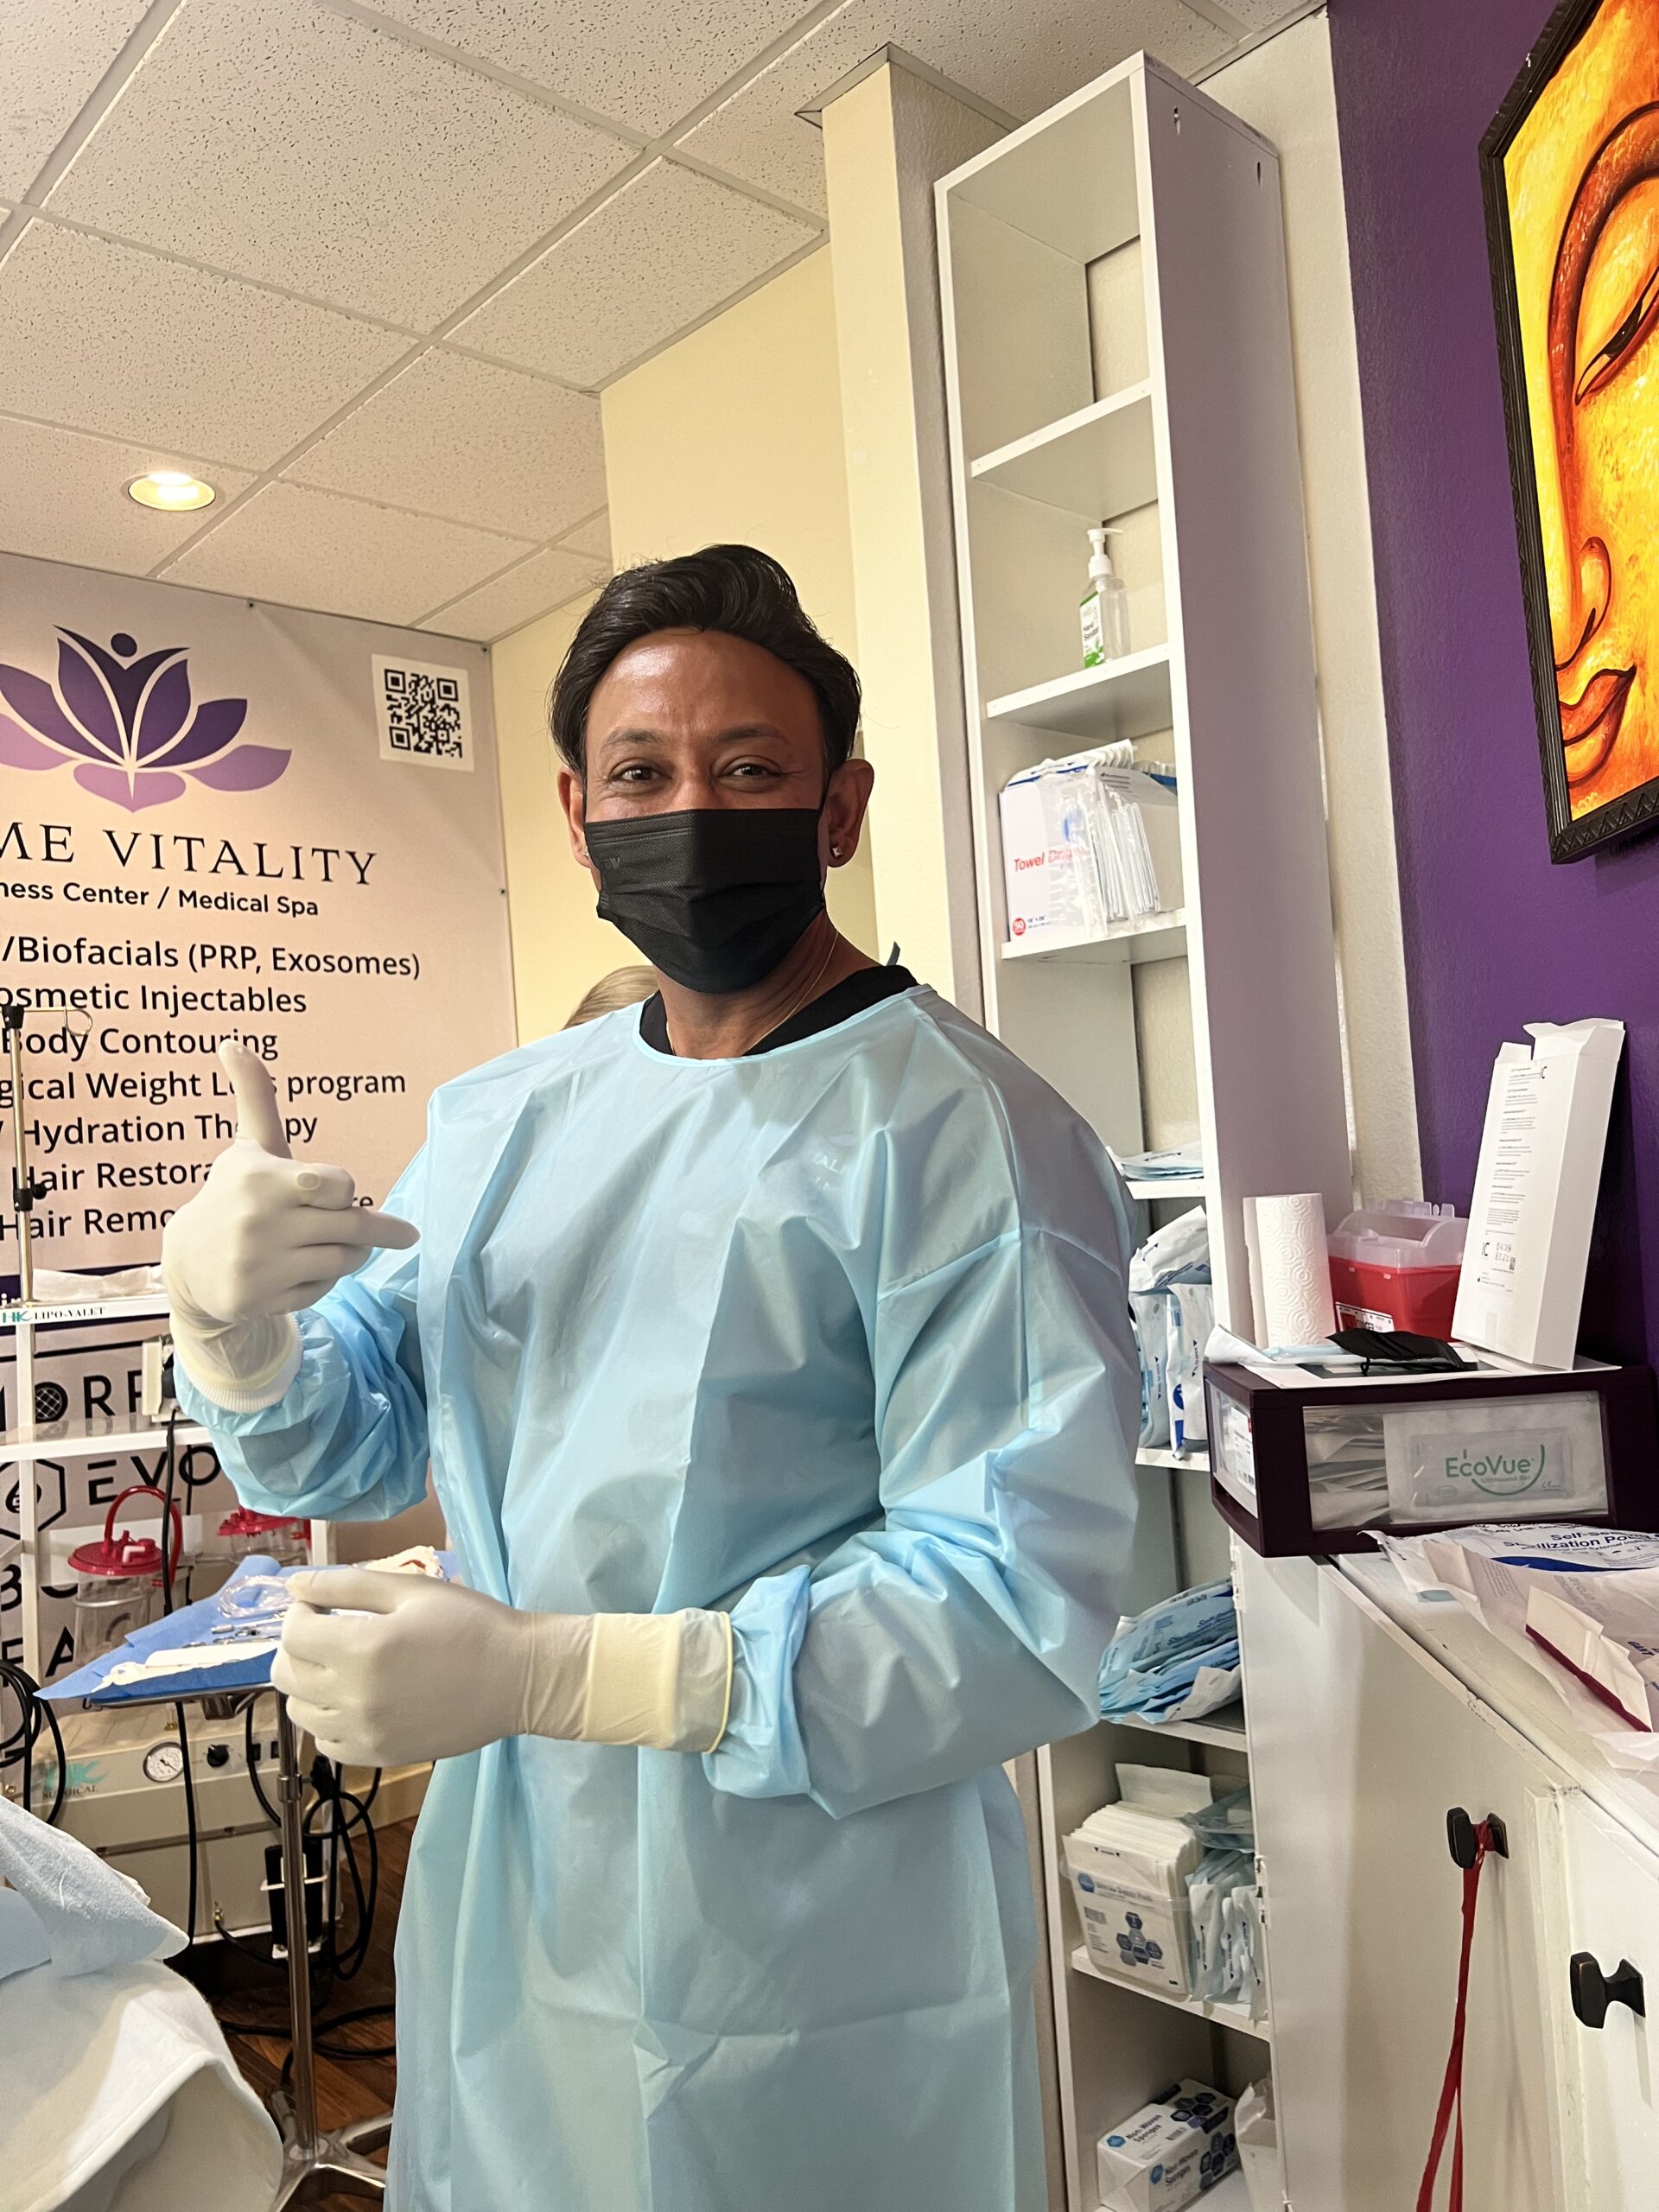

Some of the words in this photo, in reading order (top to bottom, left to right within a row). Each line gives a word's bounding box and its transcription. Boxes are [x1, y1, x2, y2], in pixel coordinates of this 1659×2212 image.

[102, 830, 377, 885] VITALITY
[1014, 851, 1045, 872] Towel
[63, 882, 149, 905] Center
[157, 887, 169, 909] /
[178, 890, 269, 912] Medical
[276, 896, 318, 918] Spa
[188, 944, 261, 974] (PRP,
[272, 947, 420, 980] Exosomes)
[141, 984, 307, 1018] Injectables
[86, 1071, 201, 1105] Weight
[288, 1075, 406, 1102] program
[194, 1114, 318, 1143] Thpy
